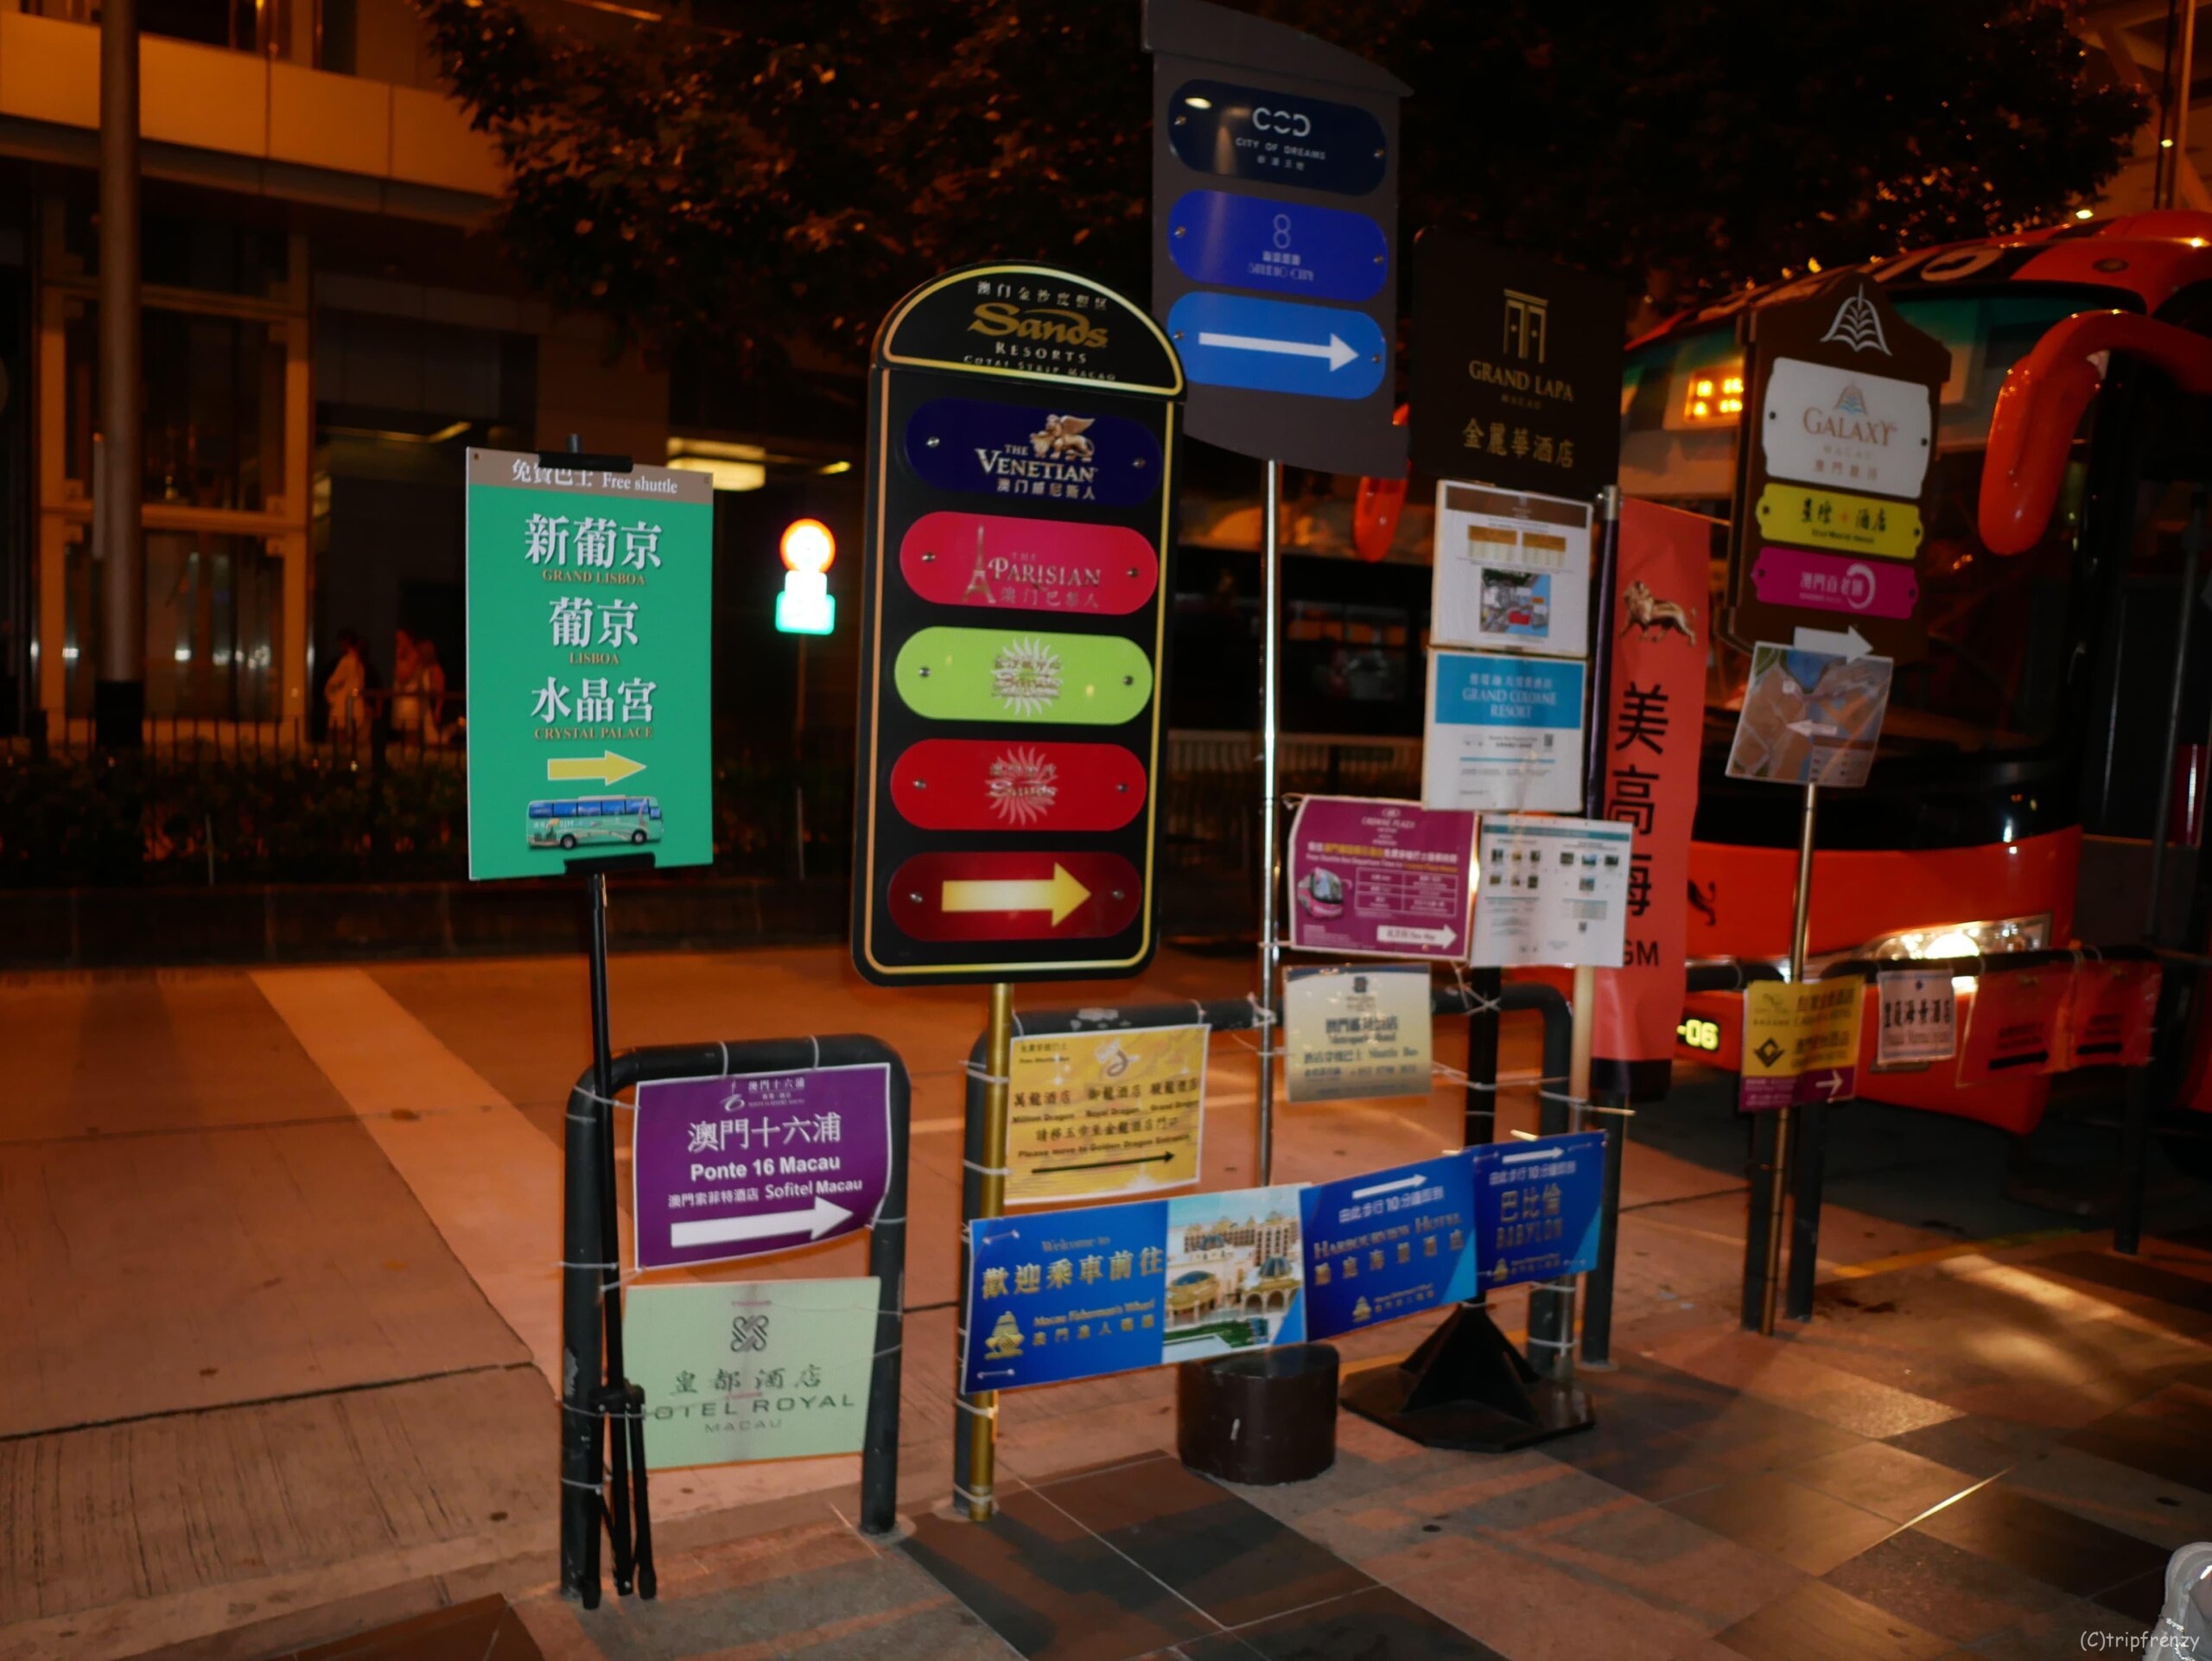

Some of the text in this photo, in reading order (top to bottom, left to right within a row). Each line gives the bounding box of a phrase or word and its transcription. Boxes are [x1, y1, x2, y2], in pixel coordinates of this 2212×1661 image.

[1236, 137, 1325, 160] CITY OF DREAMS
[967, 302, 1109, 348] Sands
[995, 341, 1088, 364] RESORTS
[1469, 360, 1574, 402] GRAND LAPA
[1802, 407, 1892, 447] GALAXY
[1004, 443, 1029, 455] THE
[975, 448, 1096, 483] VENETIAN
[602, 474, 678, 494] Free shuttle
[524, 513, 662, 570] 新葡京
[542, 568, 645, 585] GRAND LISBOA
[988, 557, 1101, 588] PARISIAN
[549, 596, 639, 648] 葡京
[569, 652, 620, 665] LISBOA
[531, 676, 658, 723] 水晶宮
[1462, 687, 1507, 703] GRAND
[1491, 703, 1533, 719] RESORT
[534, 726, 653, 740] CRYSTAL PALACE
[1044, 1112, 1074, 1122] Dragon
[1111, 1106, 1140, 1117] Dragon
[687, 1111, 842, 1154] 澳門十六浦
[1018, 1149, 1048, 1158] Please
[1052, 1147, 1076, 1155] move
[1090, 1142, 1120, 1152] Golden
[1124, 1139, 1153, 1149] Dragon
[690, 1156, 841, 1182] Ponte 16 Macau
[765, 1179, 862, 1200] Sofitel Macau
[1500, 1182, 1562, 1223] 巴比倫
[1041, 1237, 1110, 1252] Welcome to
[1497, 1218, 1562, 1251] BABYLON
[982, 1246, 1164, 1300] 歡迎乘車前往
[1124, 1298, 1155, 1313] Wharf
[670, 1364, 822, 1397] 皇都酒店
[752, 1394, 855, 1414] ROYAL
[704, 1418, 783, 1434] MACAU
